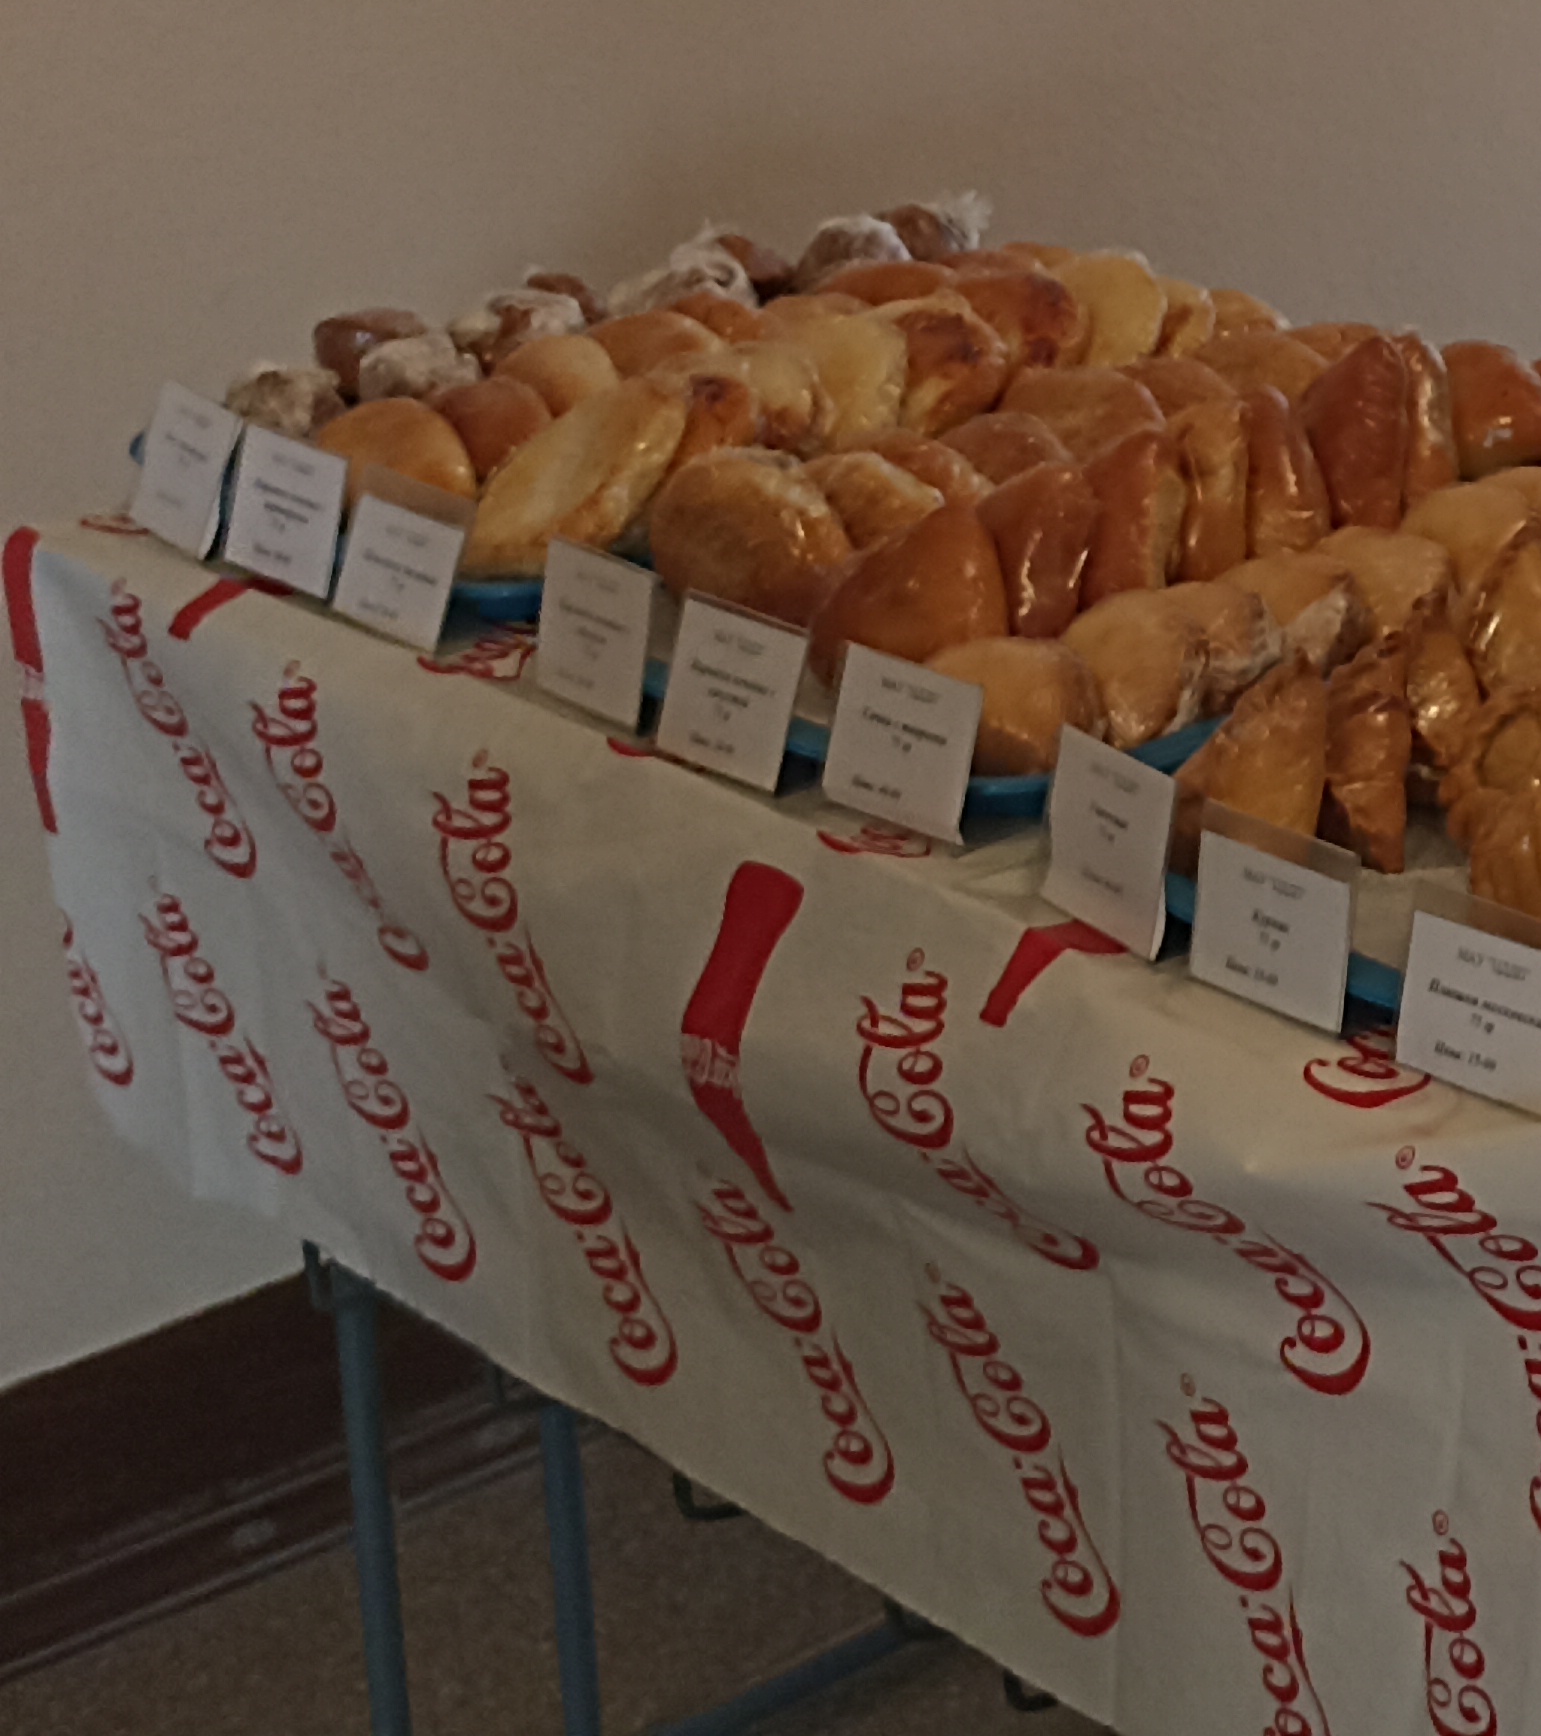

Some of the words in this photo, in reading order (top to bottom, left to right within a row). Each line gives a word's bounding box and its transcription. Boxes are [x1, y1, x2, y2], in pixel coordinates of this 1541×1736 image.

[137, 894, 303, 1175] Coca-Cola
[431, 766, 594, 1084] Coca-Cola
[305, 980, 477, 1282] Coca-Cola
[1079, 1077, 1371, 1396] Coca-Cola
[692, 1178, 895, 1505] Coca-Cola
[915, 1283, 1121, 1637] Coca-Cola
